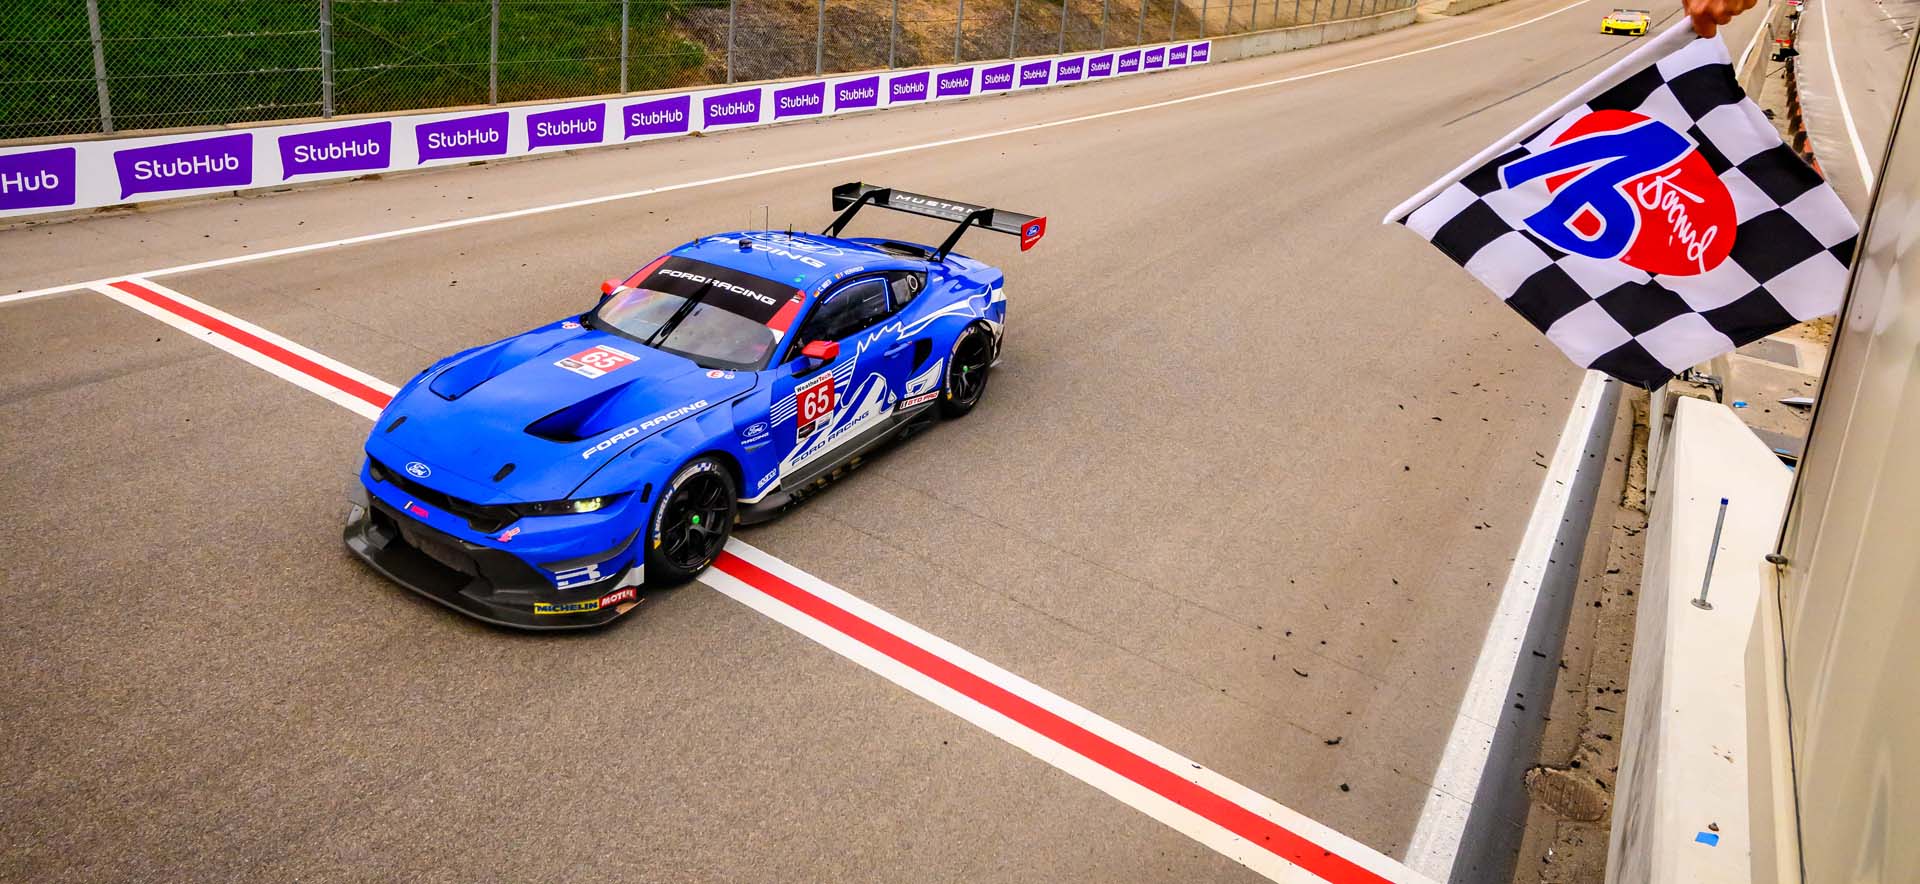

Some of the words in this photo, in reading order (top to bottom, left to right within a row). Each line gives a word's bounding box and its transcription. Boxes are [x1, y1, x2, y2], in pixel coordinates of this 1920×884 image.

[1059, 65, 1081, 76] StubHub
[1090, 62, 1111, 72] StubHub
[1119, 58, 1139, 68] StubHub
[984, 73, 1011, 85] StubHub
[1023, 69, 1048, 80] StubHub
[893, 81, 925, 95] StubHub
[940, 77, 969, 90] StubHub
[780, 93, 820, 109] StubHub
[839, 87, 875, 102] StubHub
[631, 108, 683, 127] StubHub
[710, 100, 755, 118] StubHub
[536, 118, 597, 138] StubHub
[428, 127, 499, 149] StubHub
[293, 139, 380, 164] StubHub
[134, 153, 239, 180] StubHub
[895, 194, 977, 214] MUSTAN
[658, 269, 707, 283] FORD
[706, 278, 777, 306] RACING
[580, 350, 625, 368] 65
[797, 372, 832, 393] WeatherTech
[804, 384, 830, 420] 65
[581, 427, 640, 461] FORD
[639, 399, 709, 432] RACING
[741, 432, 769, 445] RACING
[747, 424, 763, 437] Ford
[791, 441, 826, 466] FORD
[827, 410, 870, 442] RACING
[536, 601, 598, 612] MICHELIN
[601, 590, 633, 606] MOTUL
